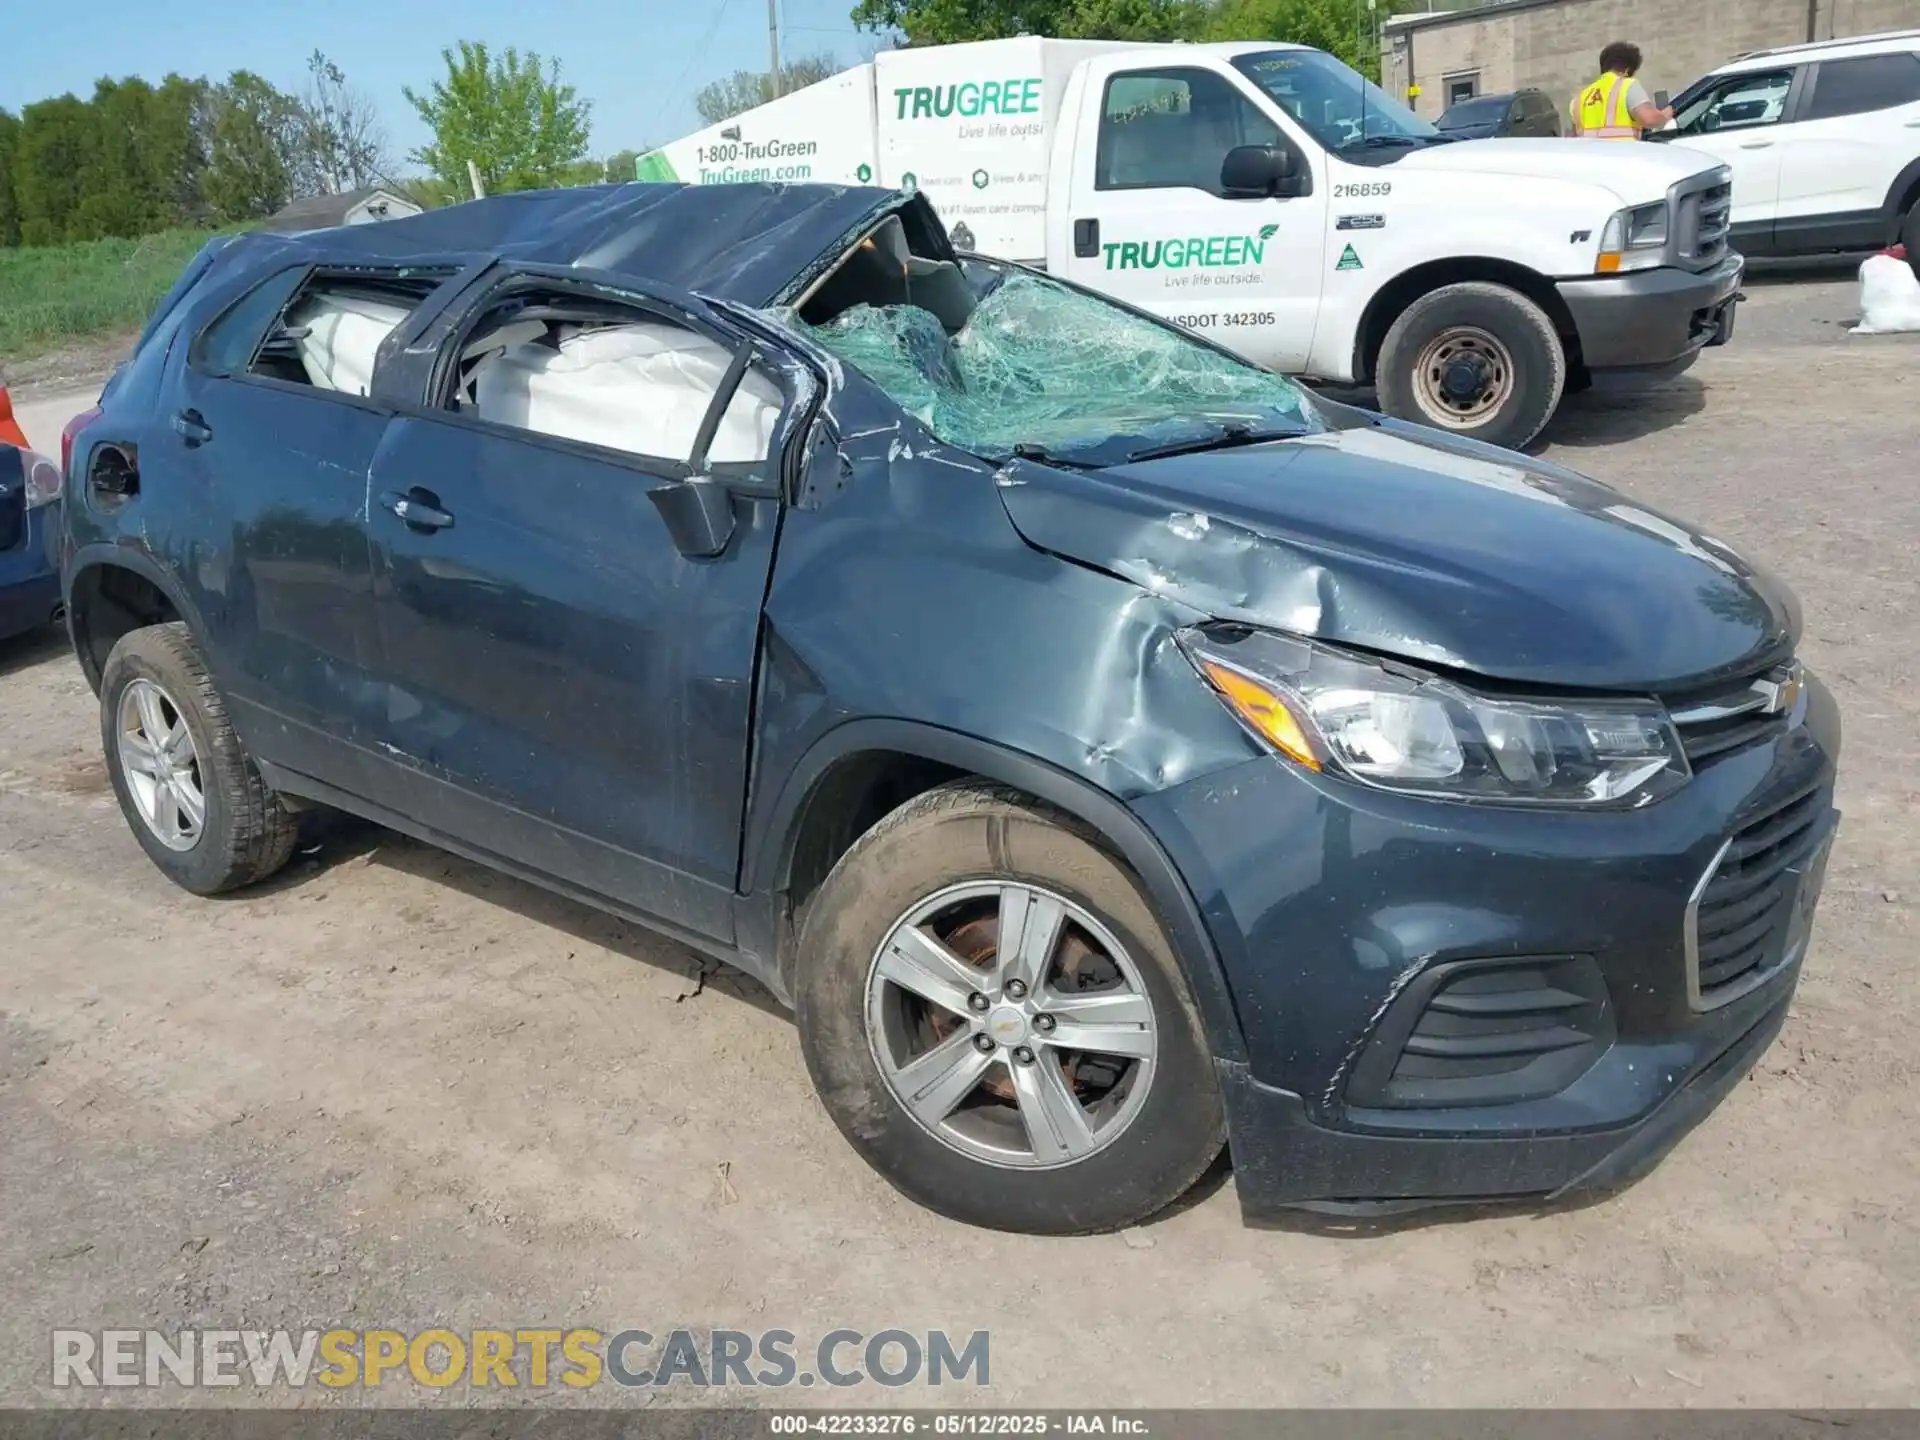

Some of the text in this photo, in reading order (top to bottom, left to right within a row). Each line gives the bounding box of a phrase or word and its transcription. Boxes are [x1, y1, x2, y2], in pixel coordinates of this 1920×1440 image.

[958, 125, 984, 139] Live
[988, 123, 1008, 137] life
[697, 139, 817, 163] 1-800-TruGreen
[698, 164, 812, 184] TruGreen.com
[1333, 182, 1392, 198] 216859
[1102, 235, 1264, 270] TRUGREEN
[1164, 275, 1189, 288] Live
[1192, 273, 1212, 287] life
[1223, 312, 1276, 327] 342305
